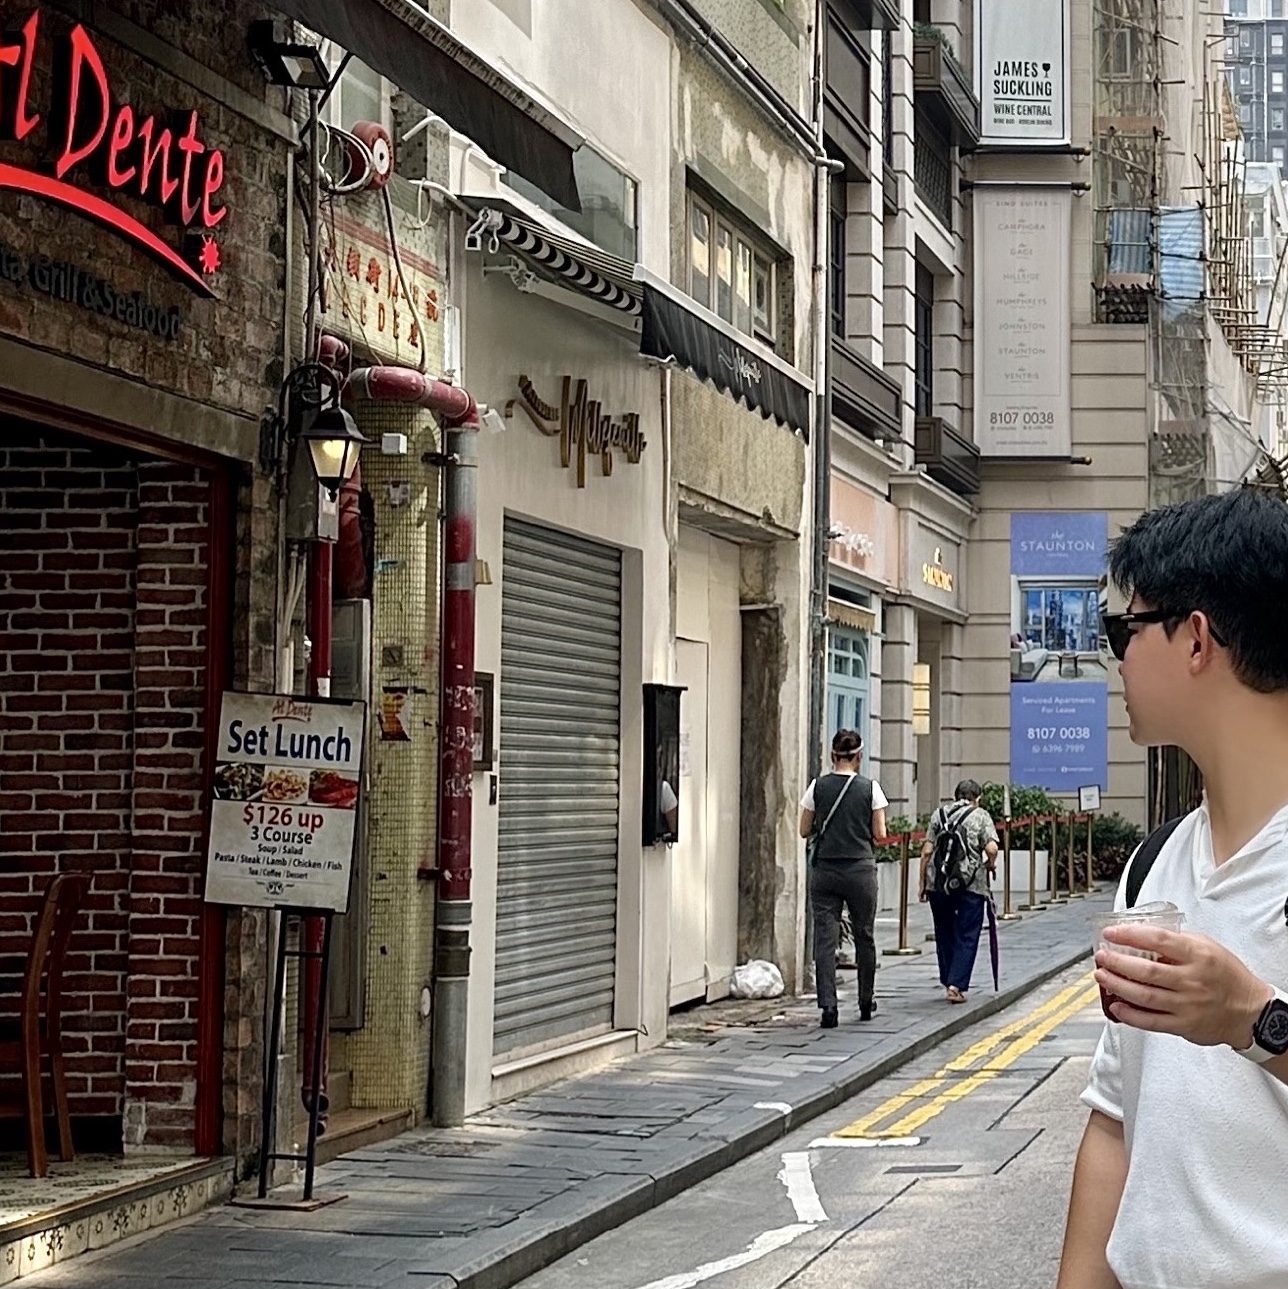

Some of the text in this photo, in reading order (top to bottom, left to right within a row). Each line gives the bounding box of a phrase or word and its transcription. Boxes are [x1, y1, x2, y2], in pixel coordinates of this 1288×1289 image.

[994, 61, 1038, 78] JAMES
[993, 80, 1052, 96] SUCKLING
[0, 8, 227, 227] l Dente
[993, 103, 1052, 116] WINE CENTRAL
[34, 254, 80, 306] Grill
[83, 272, 99, 308] &
[99, 281, 181, 340] Seafood
[990, 412, 1054, 424] 8107 0038
[1020, 540, 1095, 552] STAUNTON
[285, 700, 313, 717] Dente
[227, 719, 352, 762] Set Lunch
[1027, 727, 1090, 739] 8107 0038
[243, 803, 324, 833] $126 up
[250, 826, 313, 844] 3 Course
[258, 844, 304, 855] Soup Salad
[214, 852, 342, 870] Pasta Steak Lamb Chicken Fish
